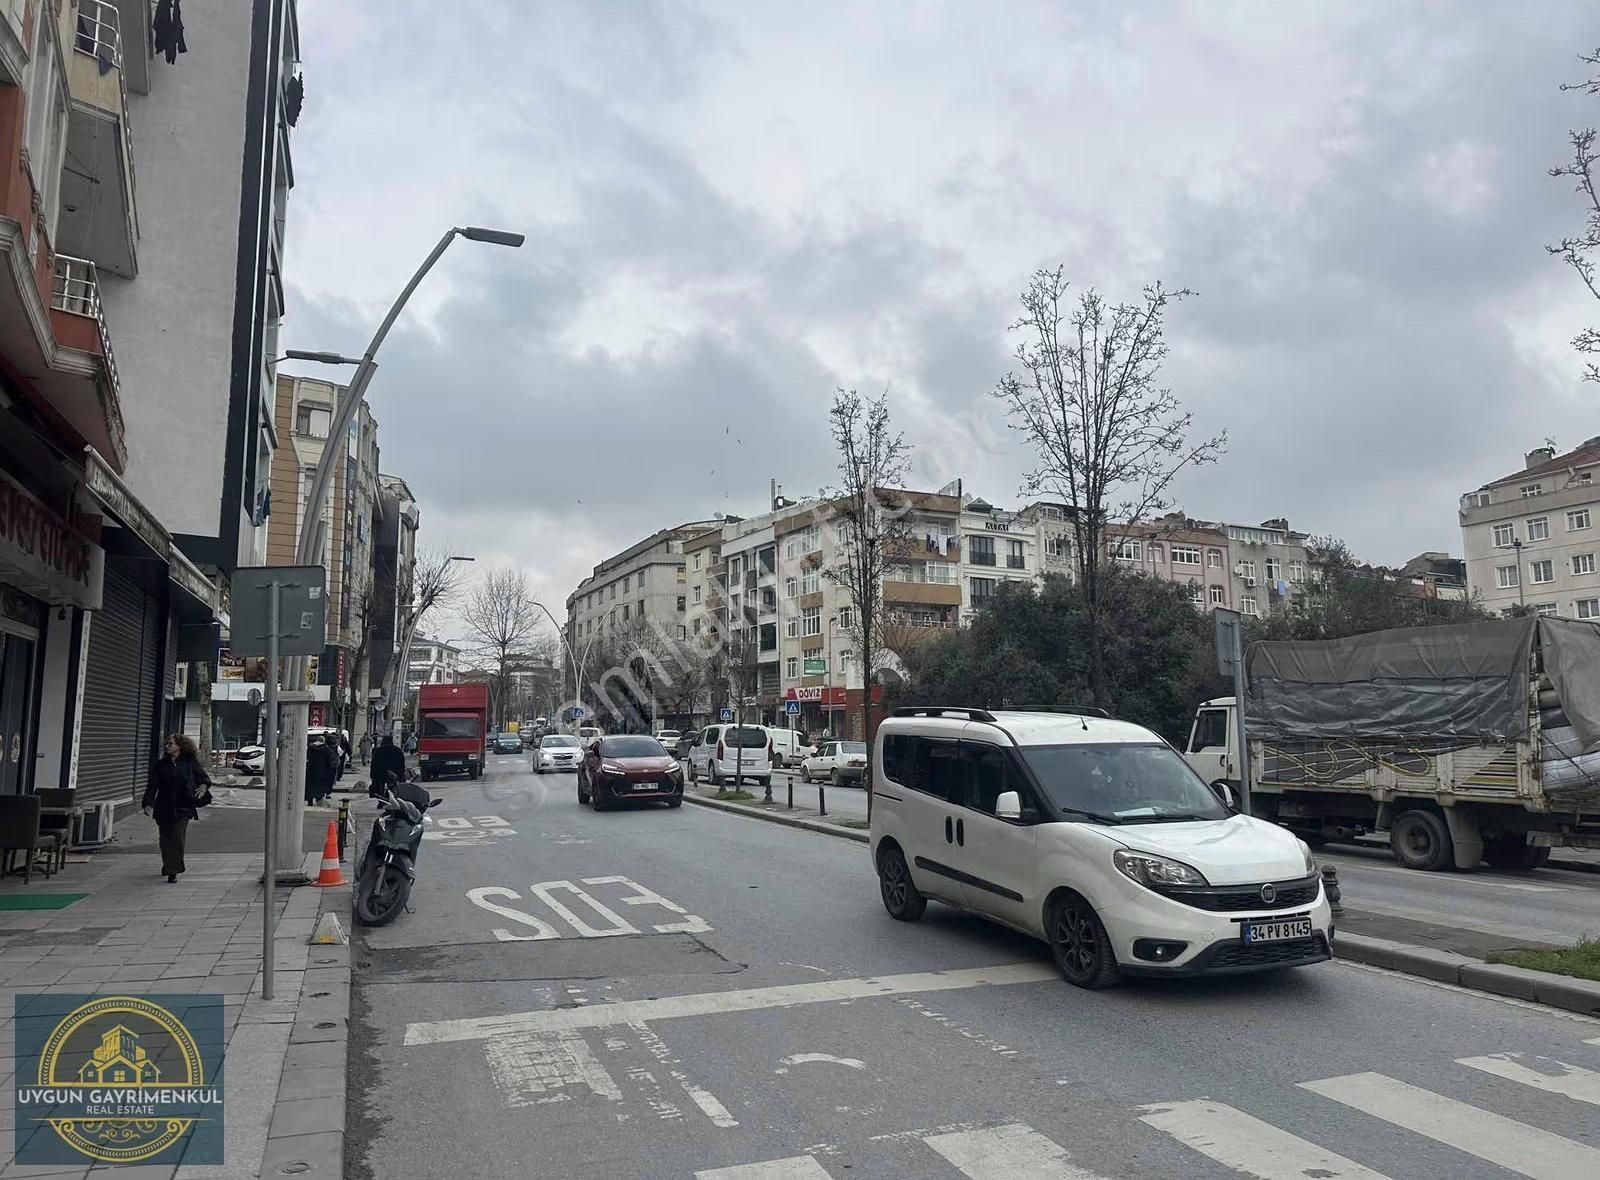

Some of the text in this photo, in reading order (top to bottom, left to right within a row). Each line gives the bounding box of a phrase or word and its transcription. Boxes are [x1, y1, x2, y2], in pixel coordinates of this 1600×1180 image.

[1251, 921, 1309, 940] 34 PV 8145
